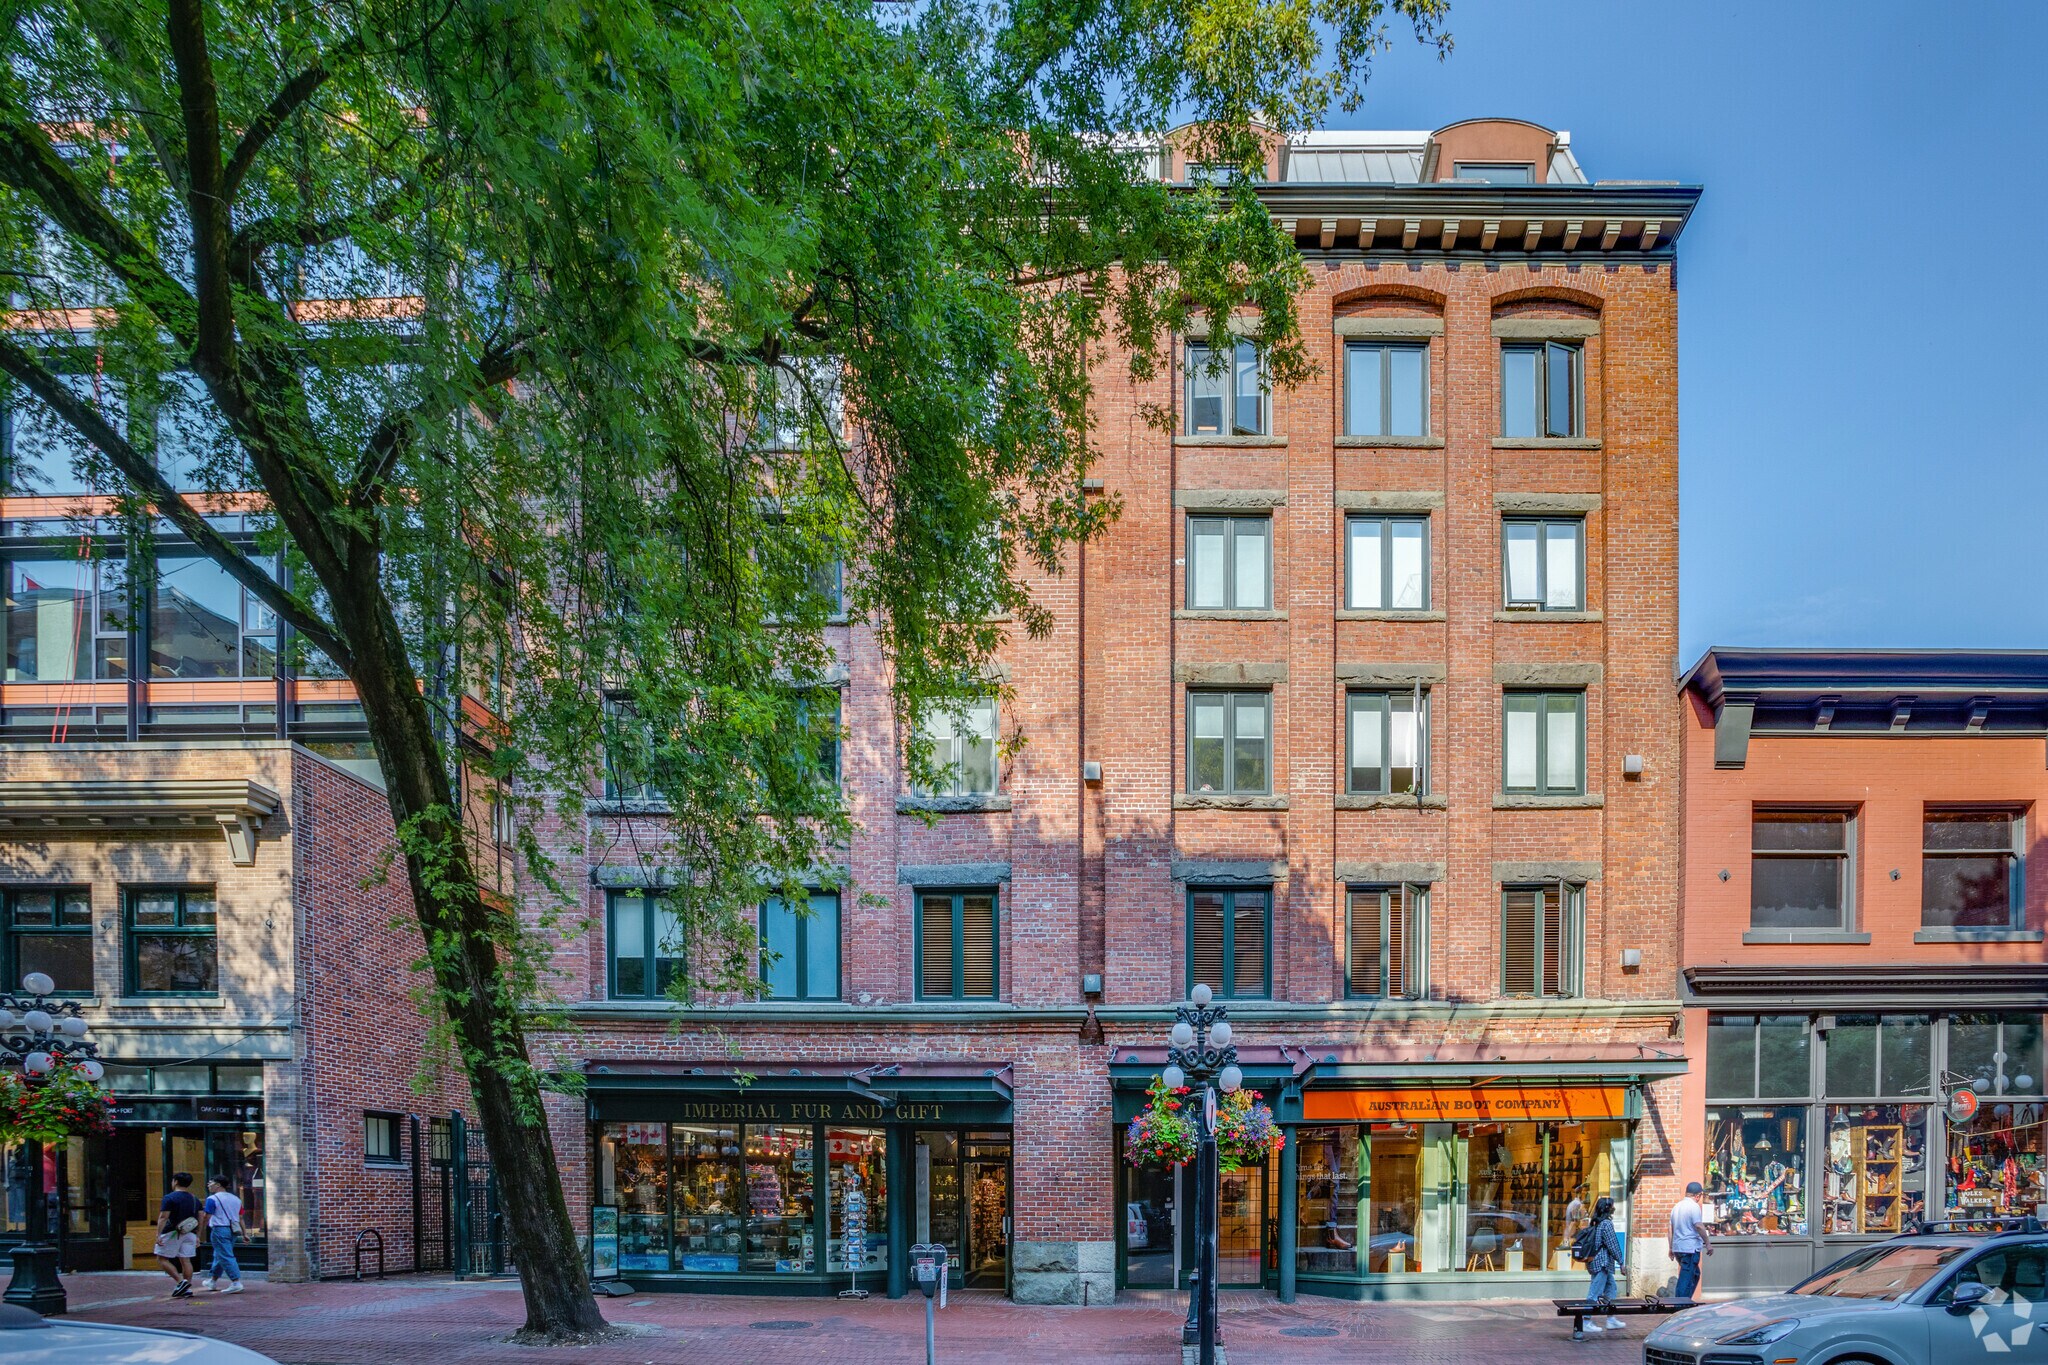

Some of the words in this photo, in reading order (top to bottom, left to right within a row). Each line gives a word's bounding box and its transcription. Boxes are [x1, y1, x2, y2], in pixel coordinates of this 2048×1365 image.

[1454, 1099, 1491, 1110] BOOT
[1495, 1098, 1562, 1110] COMPANY
[683, 1103, 781, 1119] IMPERIAL
[791, 1103, 832, 1119] FUR
[841, 1104, 883, 1120] AND
[895, 1103, 944, 1120] GIFT
